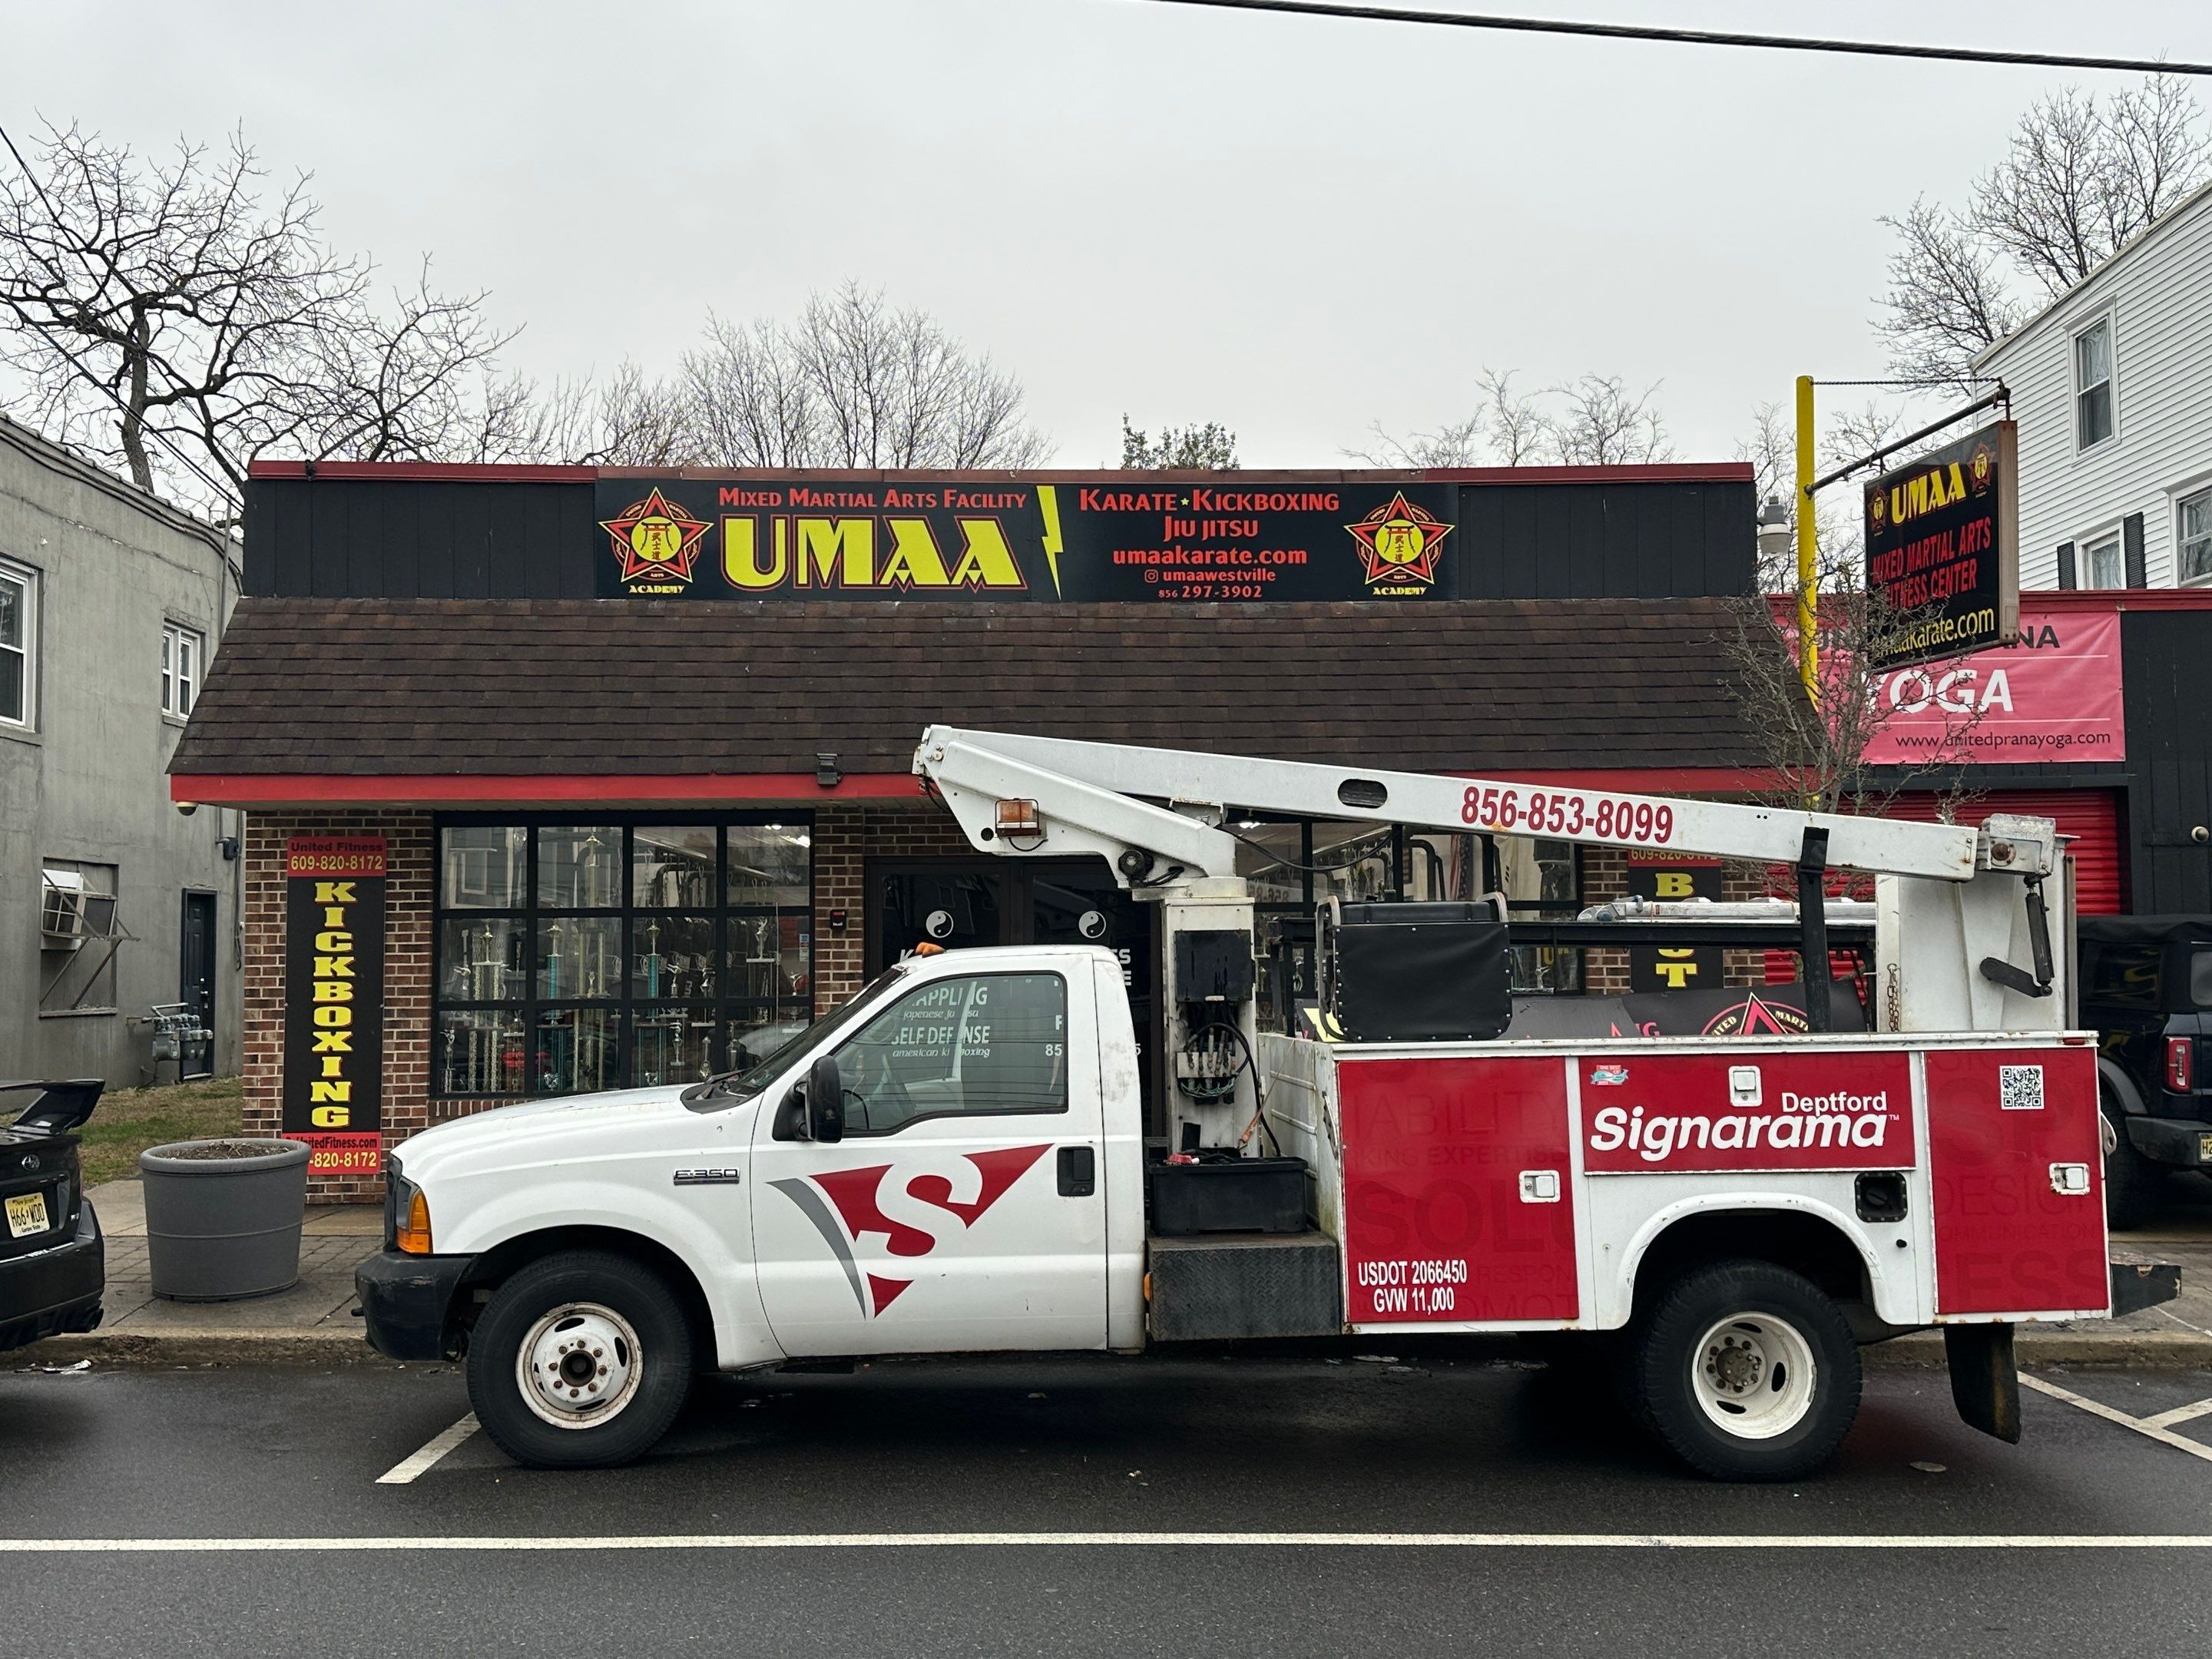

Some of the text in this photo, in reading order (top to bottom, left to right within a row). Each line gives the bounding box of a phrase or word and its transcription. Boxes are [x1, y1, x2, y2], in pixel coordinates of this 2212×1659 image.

[719, 487, 1027, 508] MIXED MARTIAL ARTS FACILITY
[1079, 488, 1339, 512] KARATE KICKBOXING
[1891, 460, 1968, 525] UMAA
[1164, 515, 1259, 542] JIU JITSU
[720, 514, 1028, 593] UMAA
[1113, 545, 1308, 565] umaakarate.com
[1872, 516, 1992, 585] MIXED MARTIAL ARTS
[1162, 568, 1277, 582] umaawestville
[1931, 558, 1978, 599] CENTER
[628, 584, 685, 594] ACADEMY
[1158, 585, 1263, 598] 856 297-3902
[1373, 586, 1427, 596] ACADEMY
[1462, 786, 1674, 844] 856-853-8099
[292, 842, 383, 852] United Fitness
[291, 855, 383, 871] 609-820-8172
[310, 882, 357, 1128] KICKBOXING
[911, 986, 988, 1006] APPLIG
[1775, 1010, 1809, 1031] MARTI
[927, 1025, 991, 1045] DEFNSE
[1782, 1091, 1888, 1116] Deptford
[1591, 1105, 1889, 1162] Signarama
[309, 1151, 377, 1167] -820-8172
[1358, 1260, 1468, 1286] USDOT 2066450
[1373, 1288, 1409, 1313] GVW
[1412, 1286, 1455, 1316] 11,000
